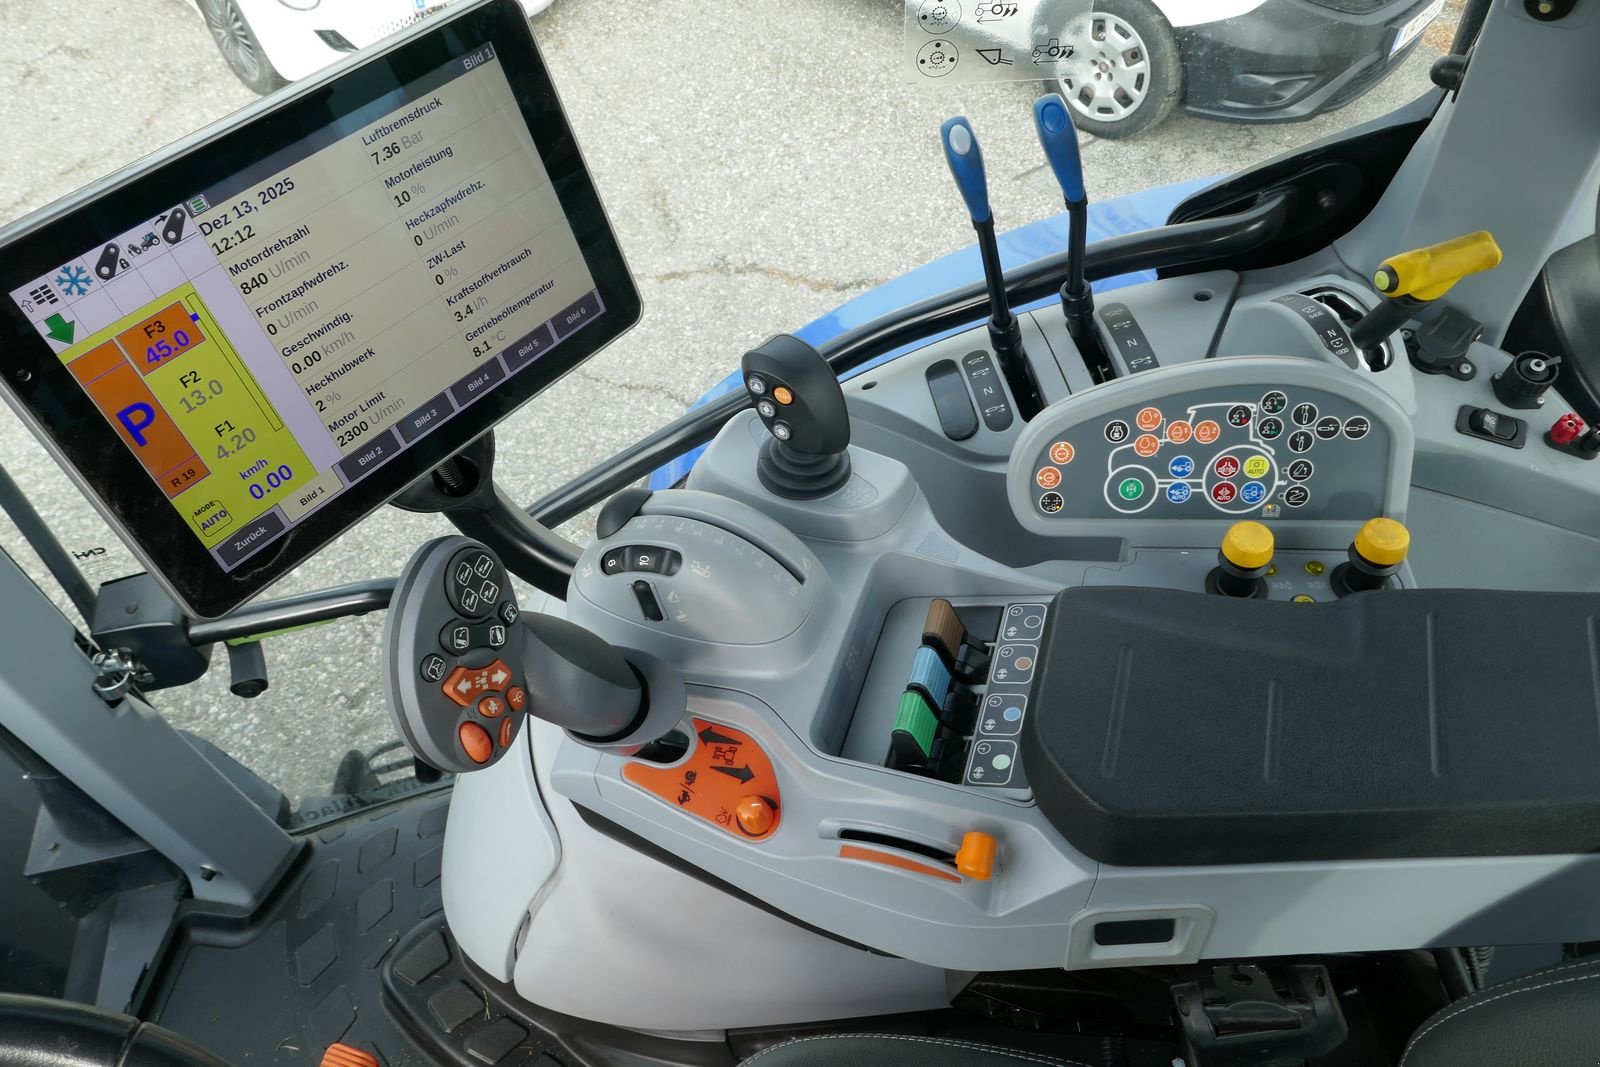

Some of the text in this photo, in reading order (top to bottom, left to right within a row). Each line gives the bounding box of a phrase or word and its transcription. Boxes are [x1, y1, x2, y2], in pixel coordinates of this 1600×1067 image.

[462, 48, 494, 71] Bild 1
[362, 96, 444, 146] Luftbremsdruck
[370, 130, 424, 166] 7.36 Bar
[384, 145, 454, 189] Motorleistung
[198, 177, 295, 237] Dez 13, 2025
[394, 183, 426, 208] 10 %
[405, 180, 486, 231] Heckzapfwdrehz.
[211, 224, 256, 256] 12:12
[413, 214, 460, 247] 0 U/min
[228, 225, 311, 277] Motordrehzahl
[426, 240, 467, 270] ZW-Last
[240, 249, 311, 295] 840 U/min
[435, 265, 458, 286] 0 %
[446, 247, 532, 307] Kraftstoffverbrauch
[255, 260, 350, 318] Frontzapfwdrehz.
[266, 300, 320, 336] 0 U/min
[454, 295, 489, 323] 3.4 l/h
[465, 279, 555, 342] Getriebeöltemperatur
[566, 307, 587, 324] Bild 6
[143, 320, 166, 339] F3
[282, 311, 353, 358] Geschwindig.
[472, 330, 507, 358] 8.1 °C
[1127, 338, 1138, 348] N
[1327, 329, 1337, 338] N
[146, 330, 190, 364] 45.0
[291, 330, 356, 375] 0.00 km/h
[518, 339, 539, 357] Bild 5
[178, 370, 202, 389] F2
[305, 347, 376, 396] Heckhubwerk
[467, 373, 490, 392] Bild 4
[179, 379, 223, 414] 13.0
[315, 391, 342, 413] 2 %
[983, 386, 993, 395] N
[115, 402, 156, 448] P
[328, 391, 386, 433] Motor Limit
[337, 397, 406, 447] 2300 U/min
[414, 409, 438, 429] Bild 3
[214, 420, 235, 437] F1
[215, 427, 257, 461] 4.20
[358, 446, 384, 467] Bild 2
[171, 467, 196, 488] R 19
[239, 457, 269, 481] km/h
[249, 463, 293, 501] 0.00
[193, 500, 216, 518] MODE
[300, 486, 325, 507] Bild 1
[201, 509, 228, 532] AUTO
[234, 525, 268, 552] Zurück
[639, 555, 650, 566] 10
